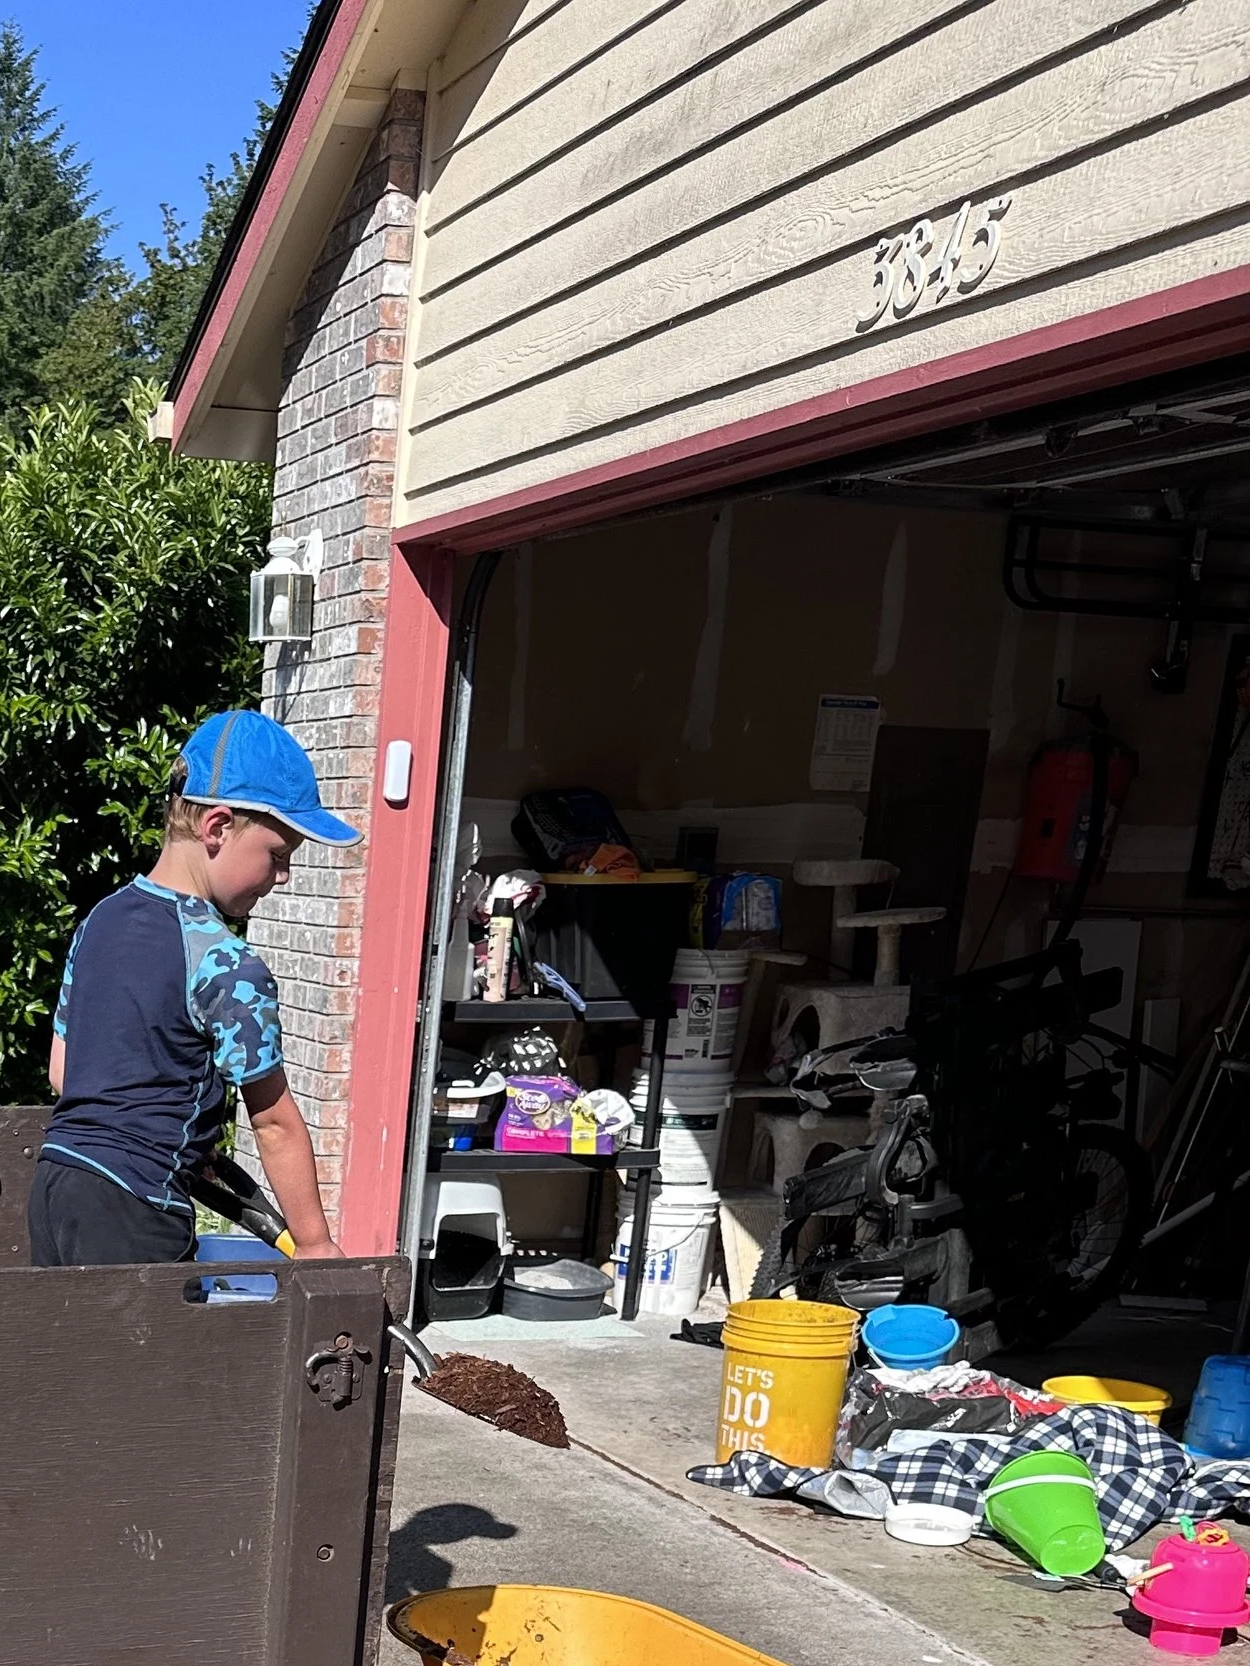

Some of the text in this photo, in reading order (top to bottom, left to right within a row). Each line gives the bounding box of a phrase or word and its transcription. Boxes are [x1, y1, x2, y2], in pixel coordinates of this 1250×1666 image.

[854, 193, 1012, 326] 3845
[727, 1362, 774, 1389] LET'S
[723, 1386, 770, 1428] DO
